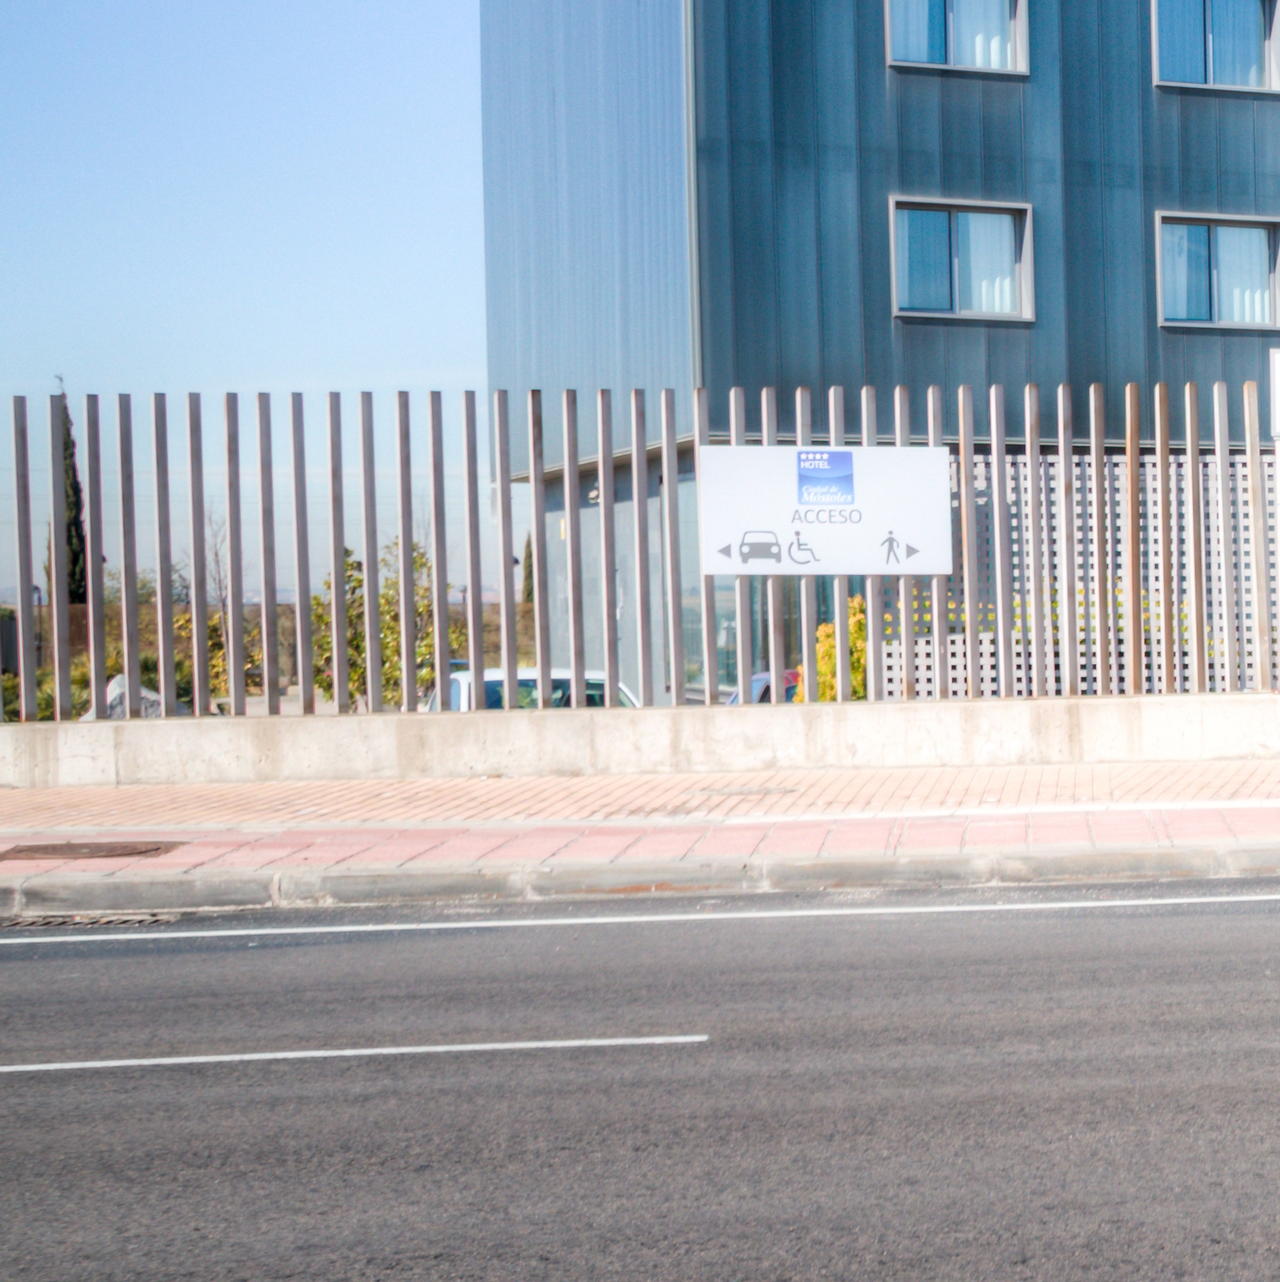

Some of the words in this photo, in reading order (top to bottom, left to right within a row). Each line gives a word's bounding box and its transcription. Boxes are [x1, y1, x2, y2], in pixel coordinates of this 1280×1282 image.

[800, 460, 831, 469] HOTEL
[801, 491, 853, 503] Móstoles
[791, 509, 863, 524] ACCESO
